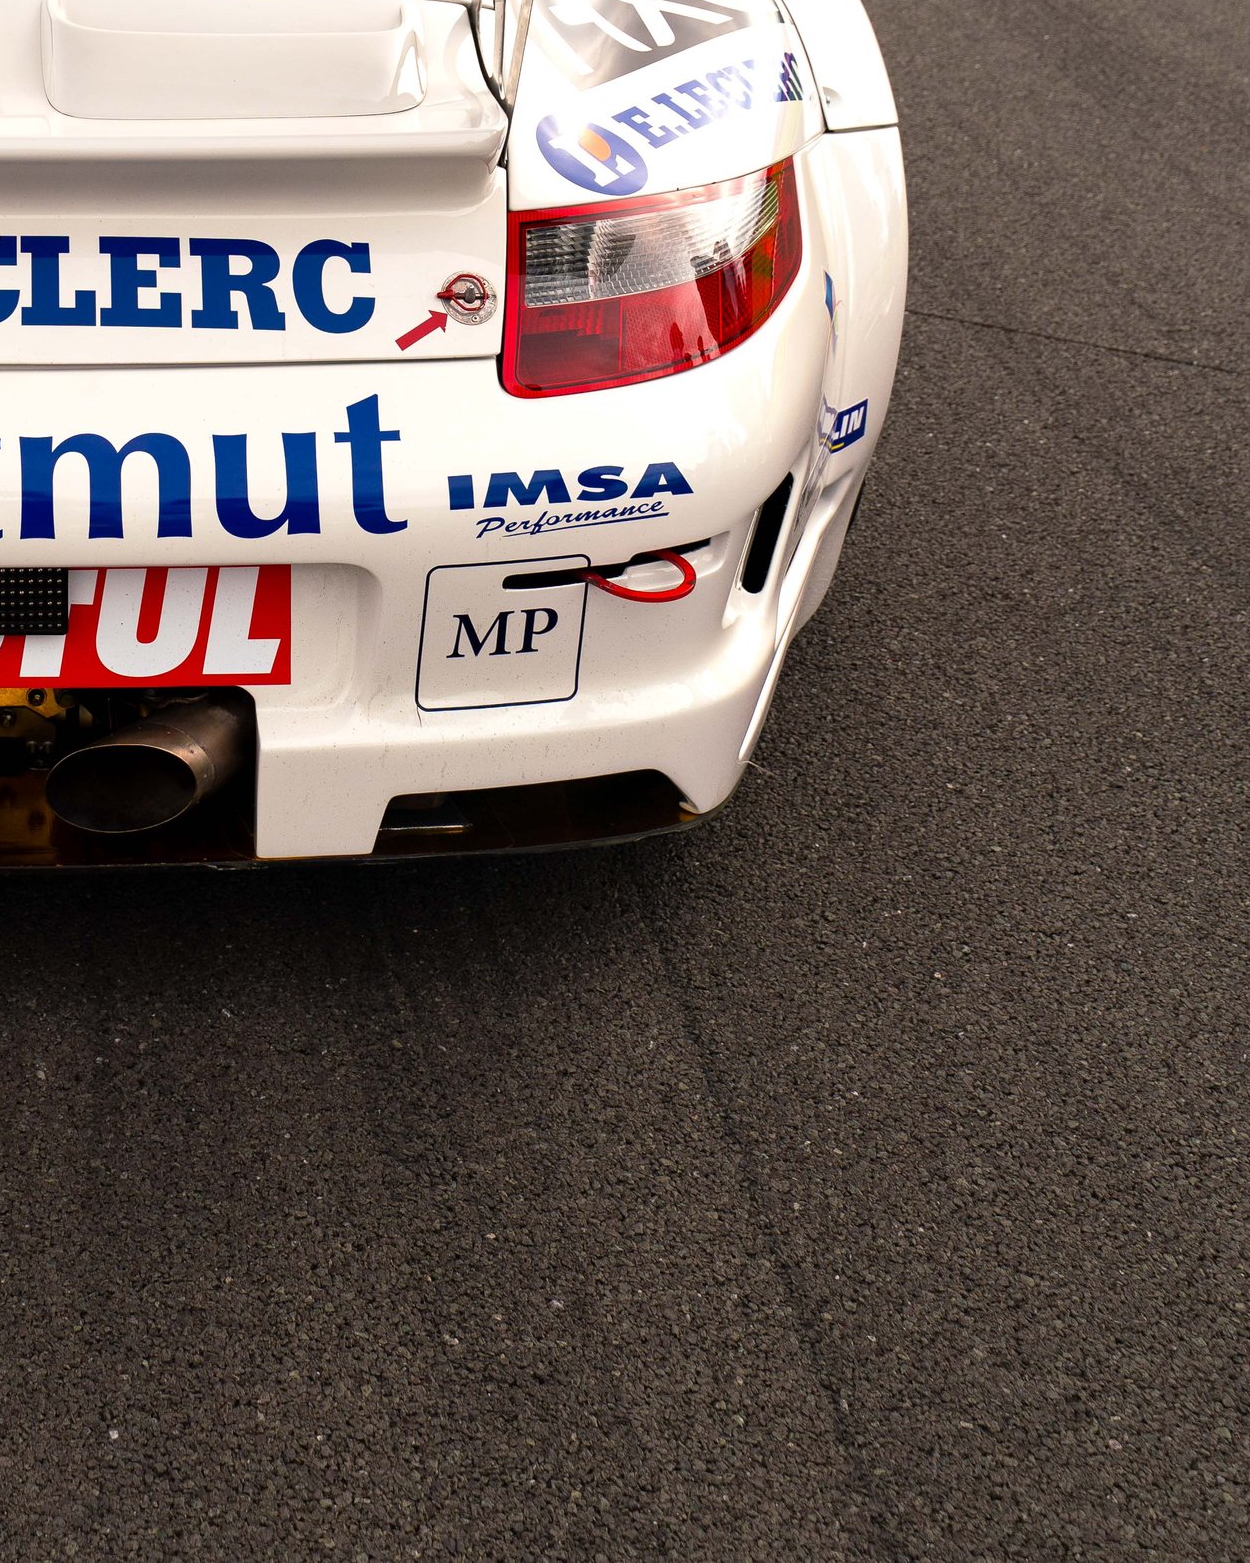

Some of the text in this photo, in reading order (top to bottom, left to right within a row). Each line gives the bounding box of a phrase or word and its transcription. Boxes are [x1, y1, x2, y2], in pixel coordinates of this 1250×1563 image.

[611, 52, 804, 149] E.LECRC
[447, 461, 694, 510] IMSA
[475, 500, 669, 538] Performance
[446, 607, 558, 659] MP
